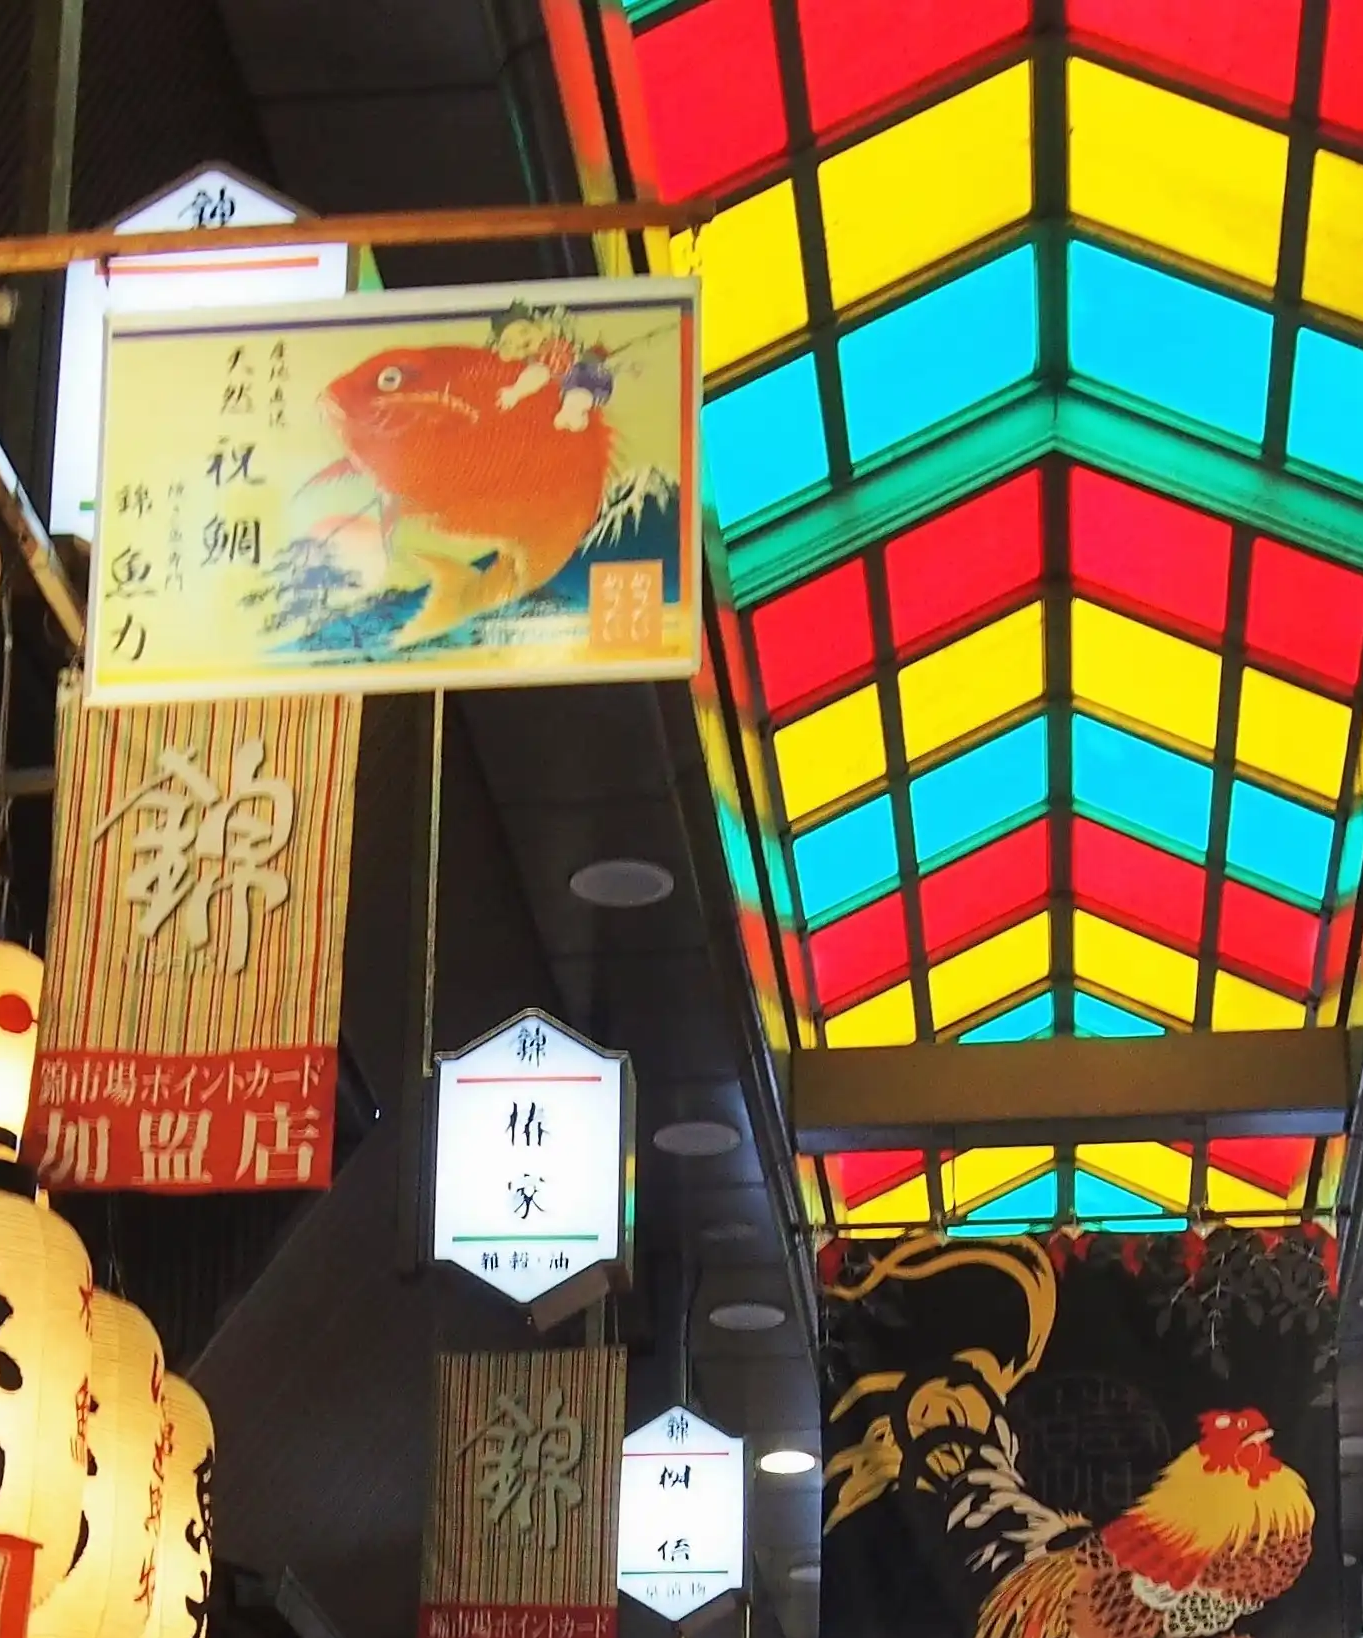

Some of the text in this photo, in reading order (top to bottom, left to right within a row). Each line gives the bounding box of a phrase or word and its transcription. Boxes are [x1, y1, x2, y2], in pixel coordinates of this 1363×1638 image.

[200, 435, 267, 567] 祝鯛
[92, 738, 297, 976] 錦
[40, 1055, 327, 1106] 錦市場ポイントカード
[516, 1024, 547, 1067] 錦
[39, 1101, 321, 1185] 加盟店
[458, 1388, 583, 1550] 錦
